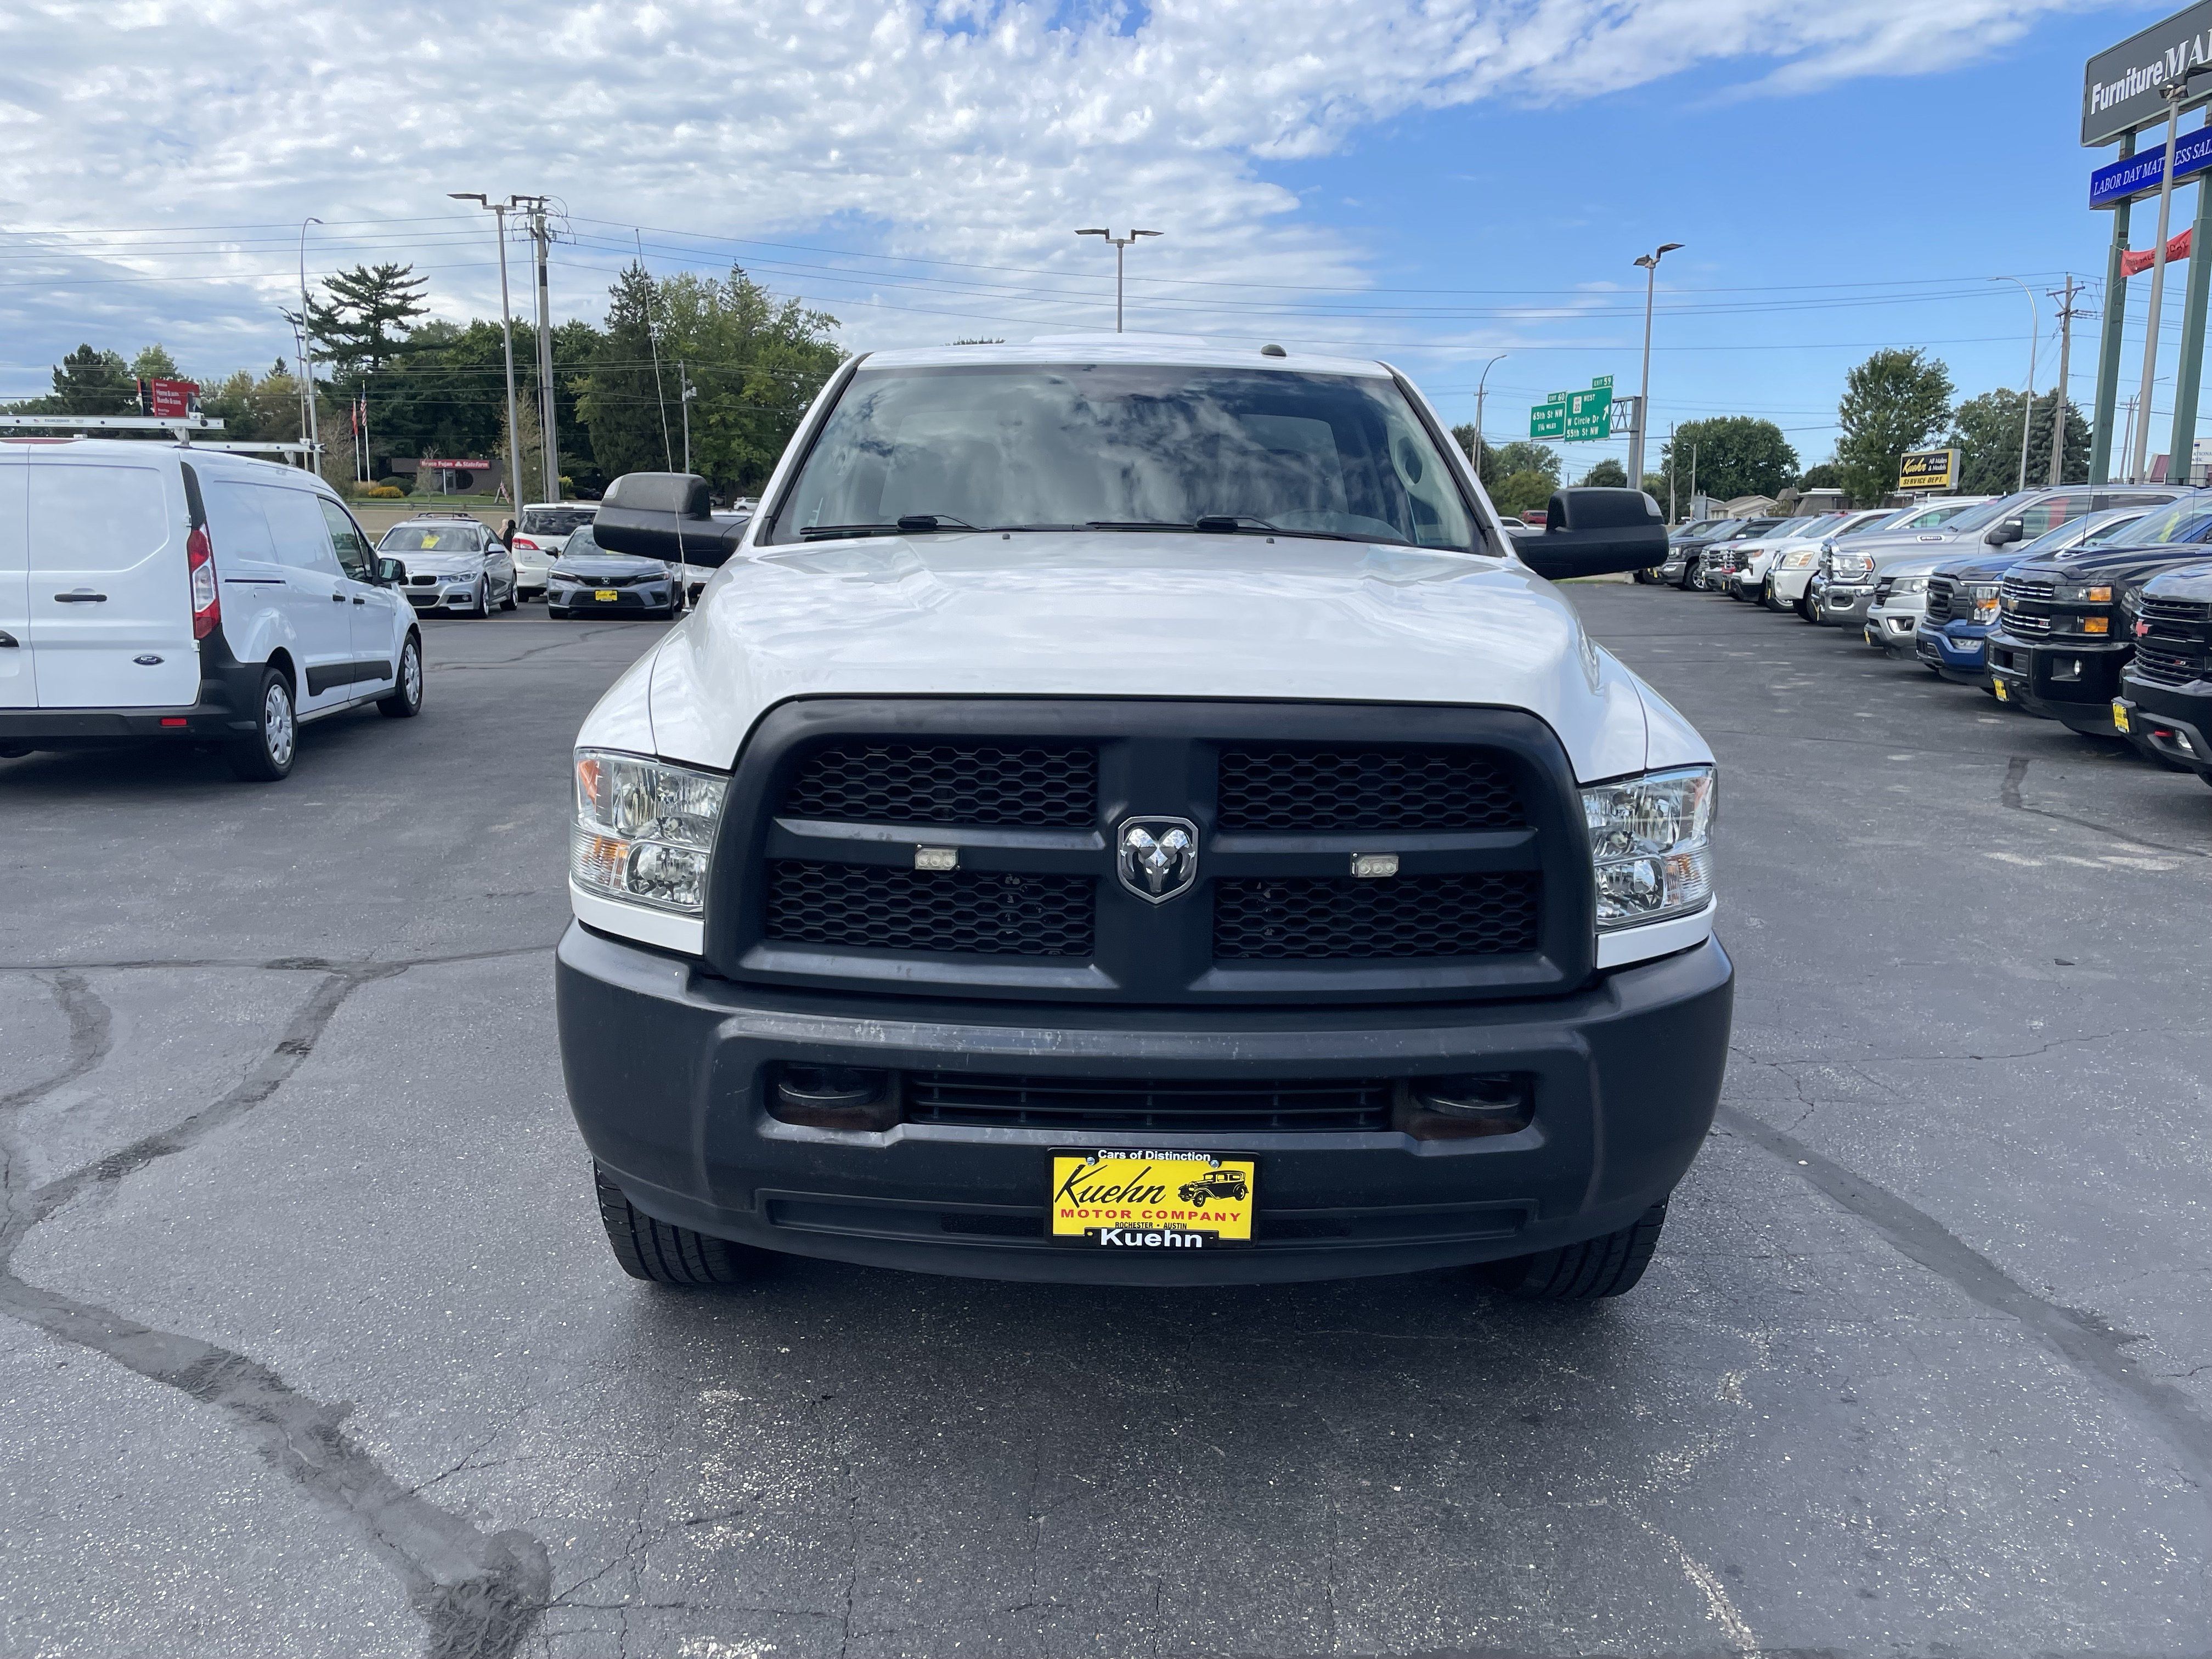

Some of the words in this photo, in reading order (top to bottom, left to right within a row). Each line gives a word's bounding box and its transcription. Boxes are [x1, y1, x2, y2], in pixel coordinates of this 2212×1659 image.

[2094, 173, 2122, 196] LABOR
[2123, 165, 2143, 185] DAY
[2142, 146, 2192, 178] MATESS
[2166, 240, 2188, 255] DAY
[1604, 377, 1611, 386] 59
[1575, 403, 1580, 411] 22
[1533, 411, 1545, 421] 65th
[1547, 410, 1553, 419] St
[1555, 409, 1563, 417] NW
[1567, 418, 1572, 426] W
[1574, 417, 1590, 426] Circle
[1592, 415, 1599, 424] Dr
[1566, 429, 1579, 438] 55th
[1582, 427, 1588, 437] St
[1590, 426, 1599, 435] NW
[1902, 457, 1927, 475] Kuehn
[1098, 1149, 1126, 1160] Cars
[1130, 1150, 1143, 1160] of
[1146, 1150, 1211, 1161] Distinction
[1054, 1164, 1166, 1209] Kuehn
[1061, 1209, 1132, 1219] MOTOR
[1142, 1210, 1242, 1222] COMPANY
[1101, 1228, 1203, 1248] Kuehn
